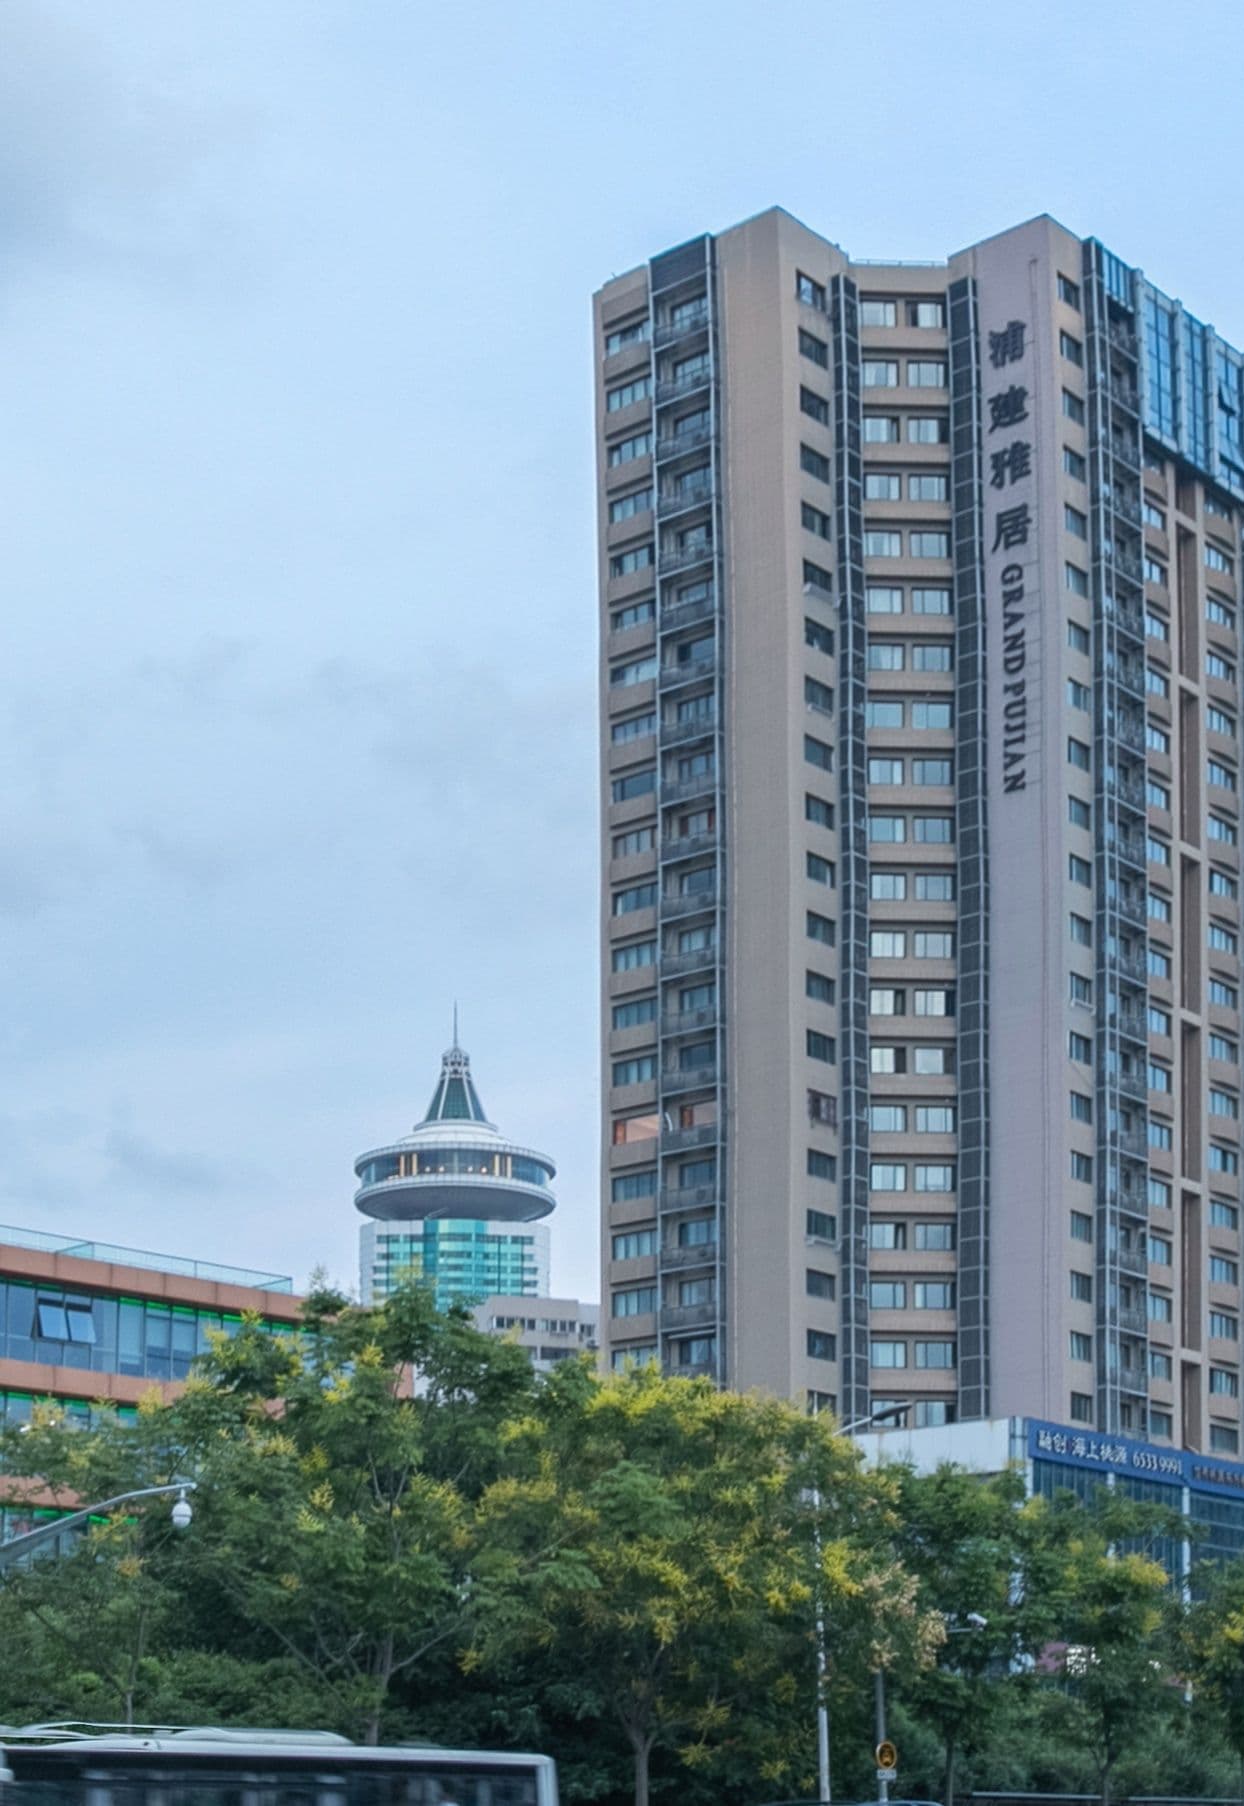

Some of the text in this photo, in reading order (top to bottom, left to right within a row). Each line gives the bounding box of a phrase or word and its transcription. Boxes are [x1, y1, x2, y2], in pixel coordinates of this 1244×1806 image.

[987, 319, 1032, 554] 浦建雅居
[1001, 563, 1026, 794] GRAND PUJIAN
